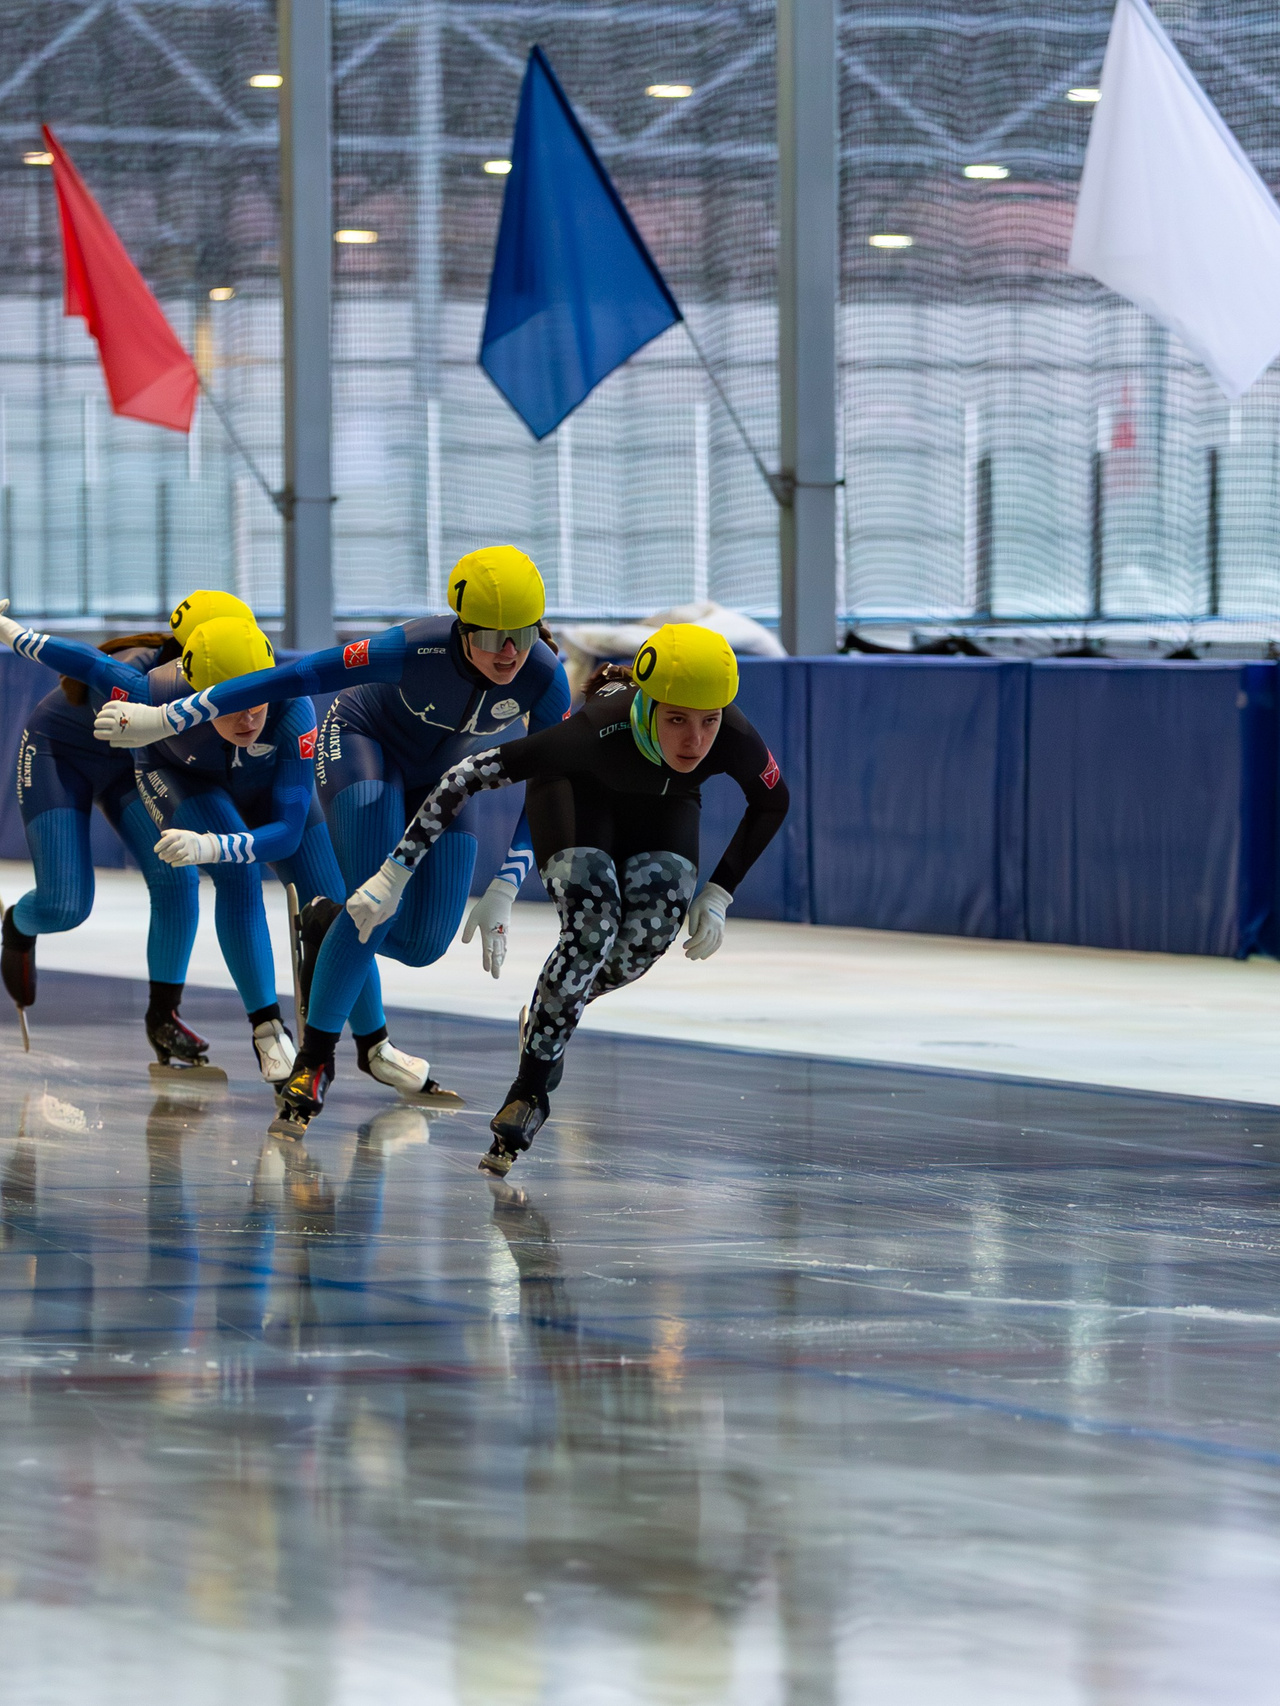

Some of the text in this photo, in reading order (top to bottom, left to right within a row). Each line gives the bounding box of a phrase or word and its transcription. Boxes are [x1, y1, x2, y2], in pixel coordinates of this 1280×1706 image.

[453, 579, 468, 613] 1
[170, 600, 191, 630] 5
[182, 650, 194, 683] 4
[417, 647, 447, 655] corsa
[632, 640, 657, 682] 0
